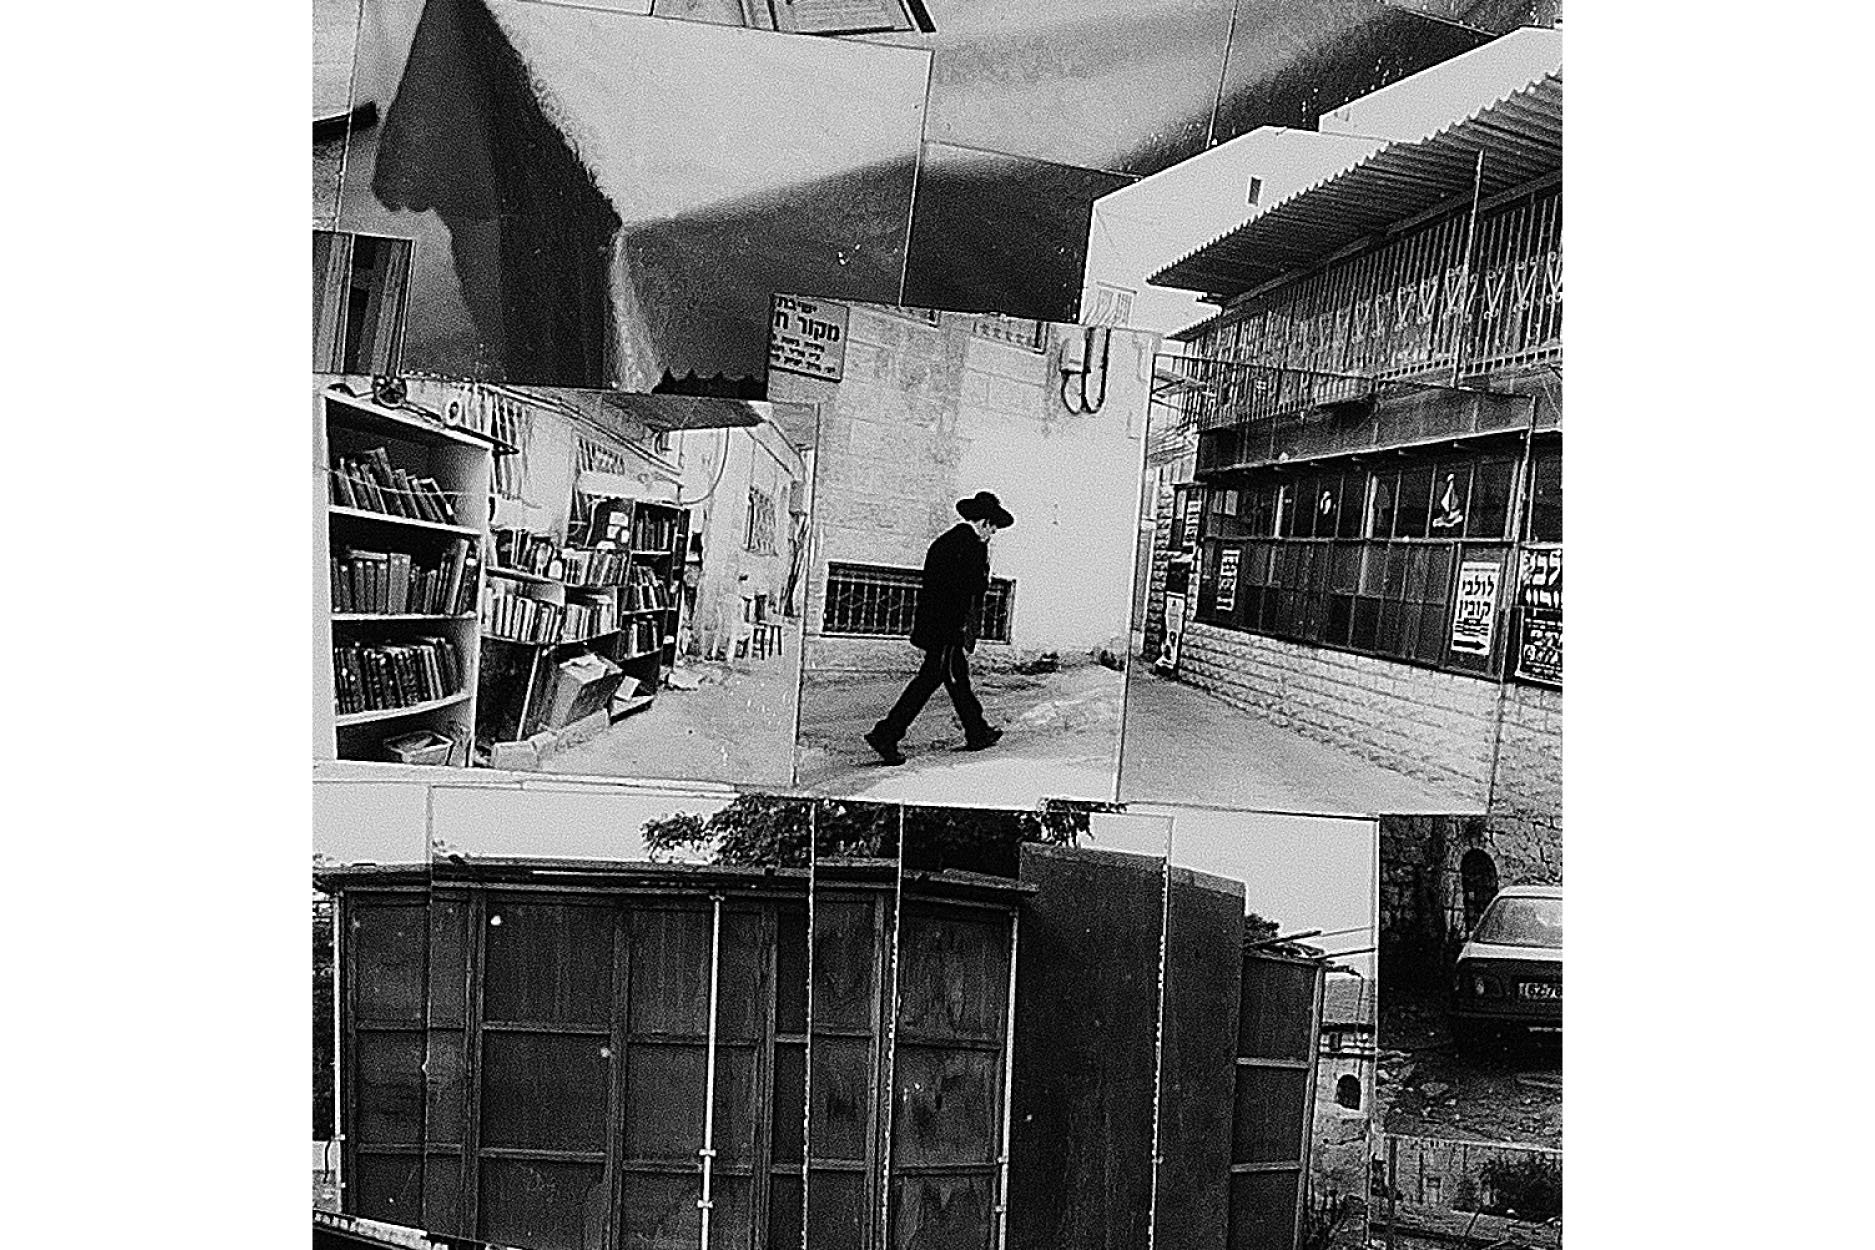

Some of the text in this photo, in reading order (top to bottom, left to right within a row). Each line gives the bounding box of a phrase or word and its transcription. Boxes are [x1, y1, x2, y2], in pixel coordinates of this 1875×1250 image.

[798, 316, 840, 342] מקור
[1462, 575, 1495, 597] לולבי
[1458, 600, 1491, 621] קובין
